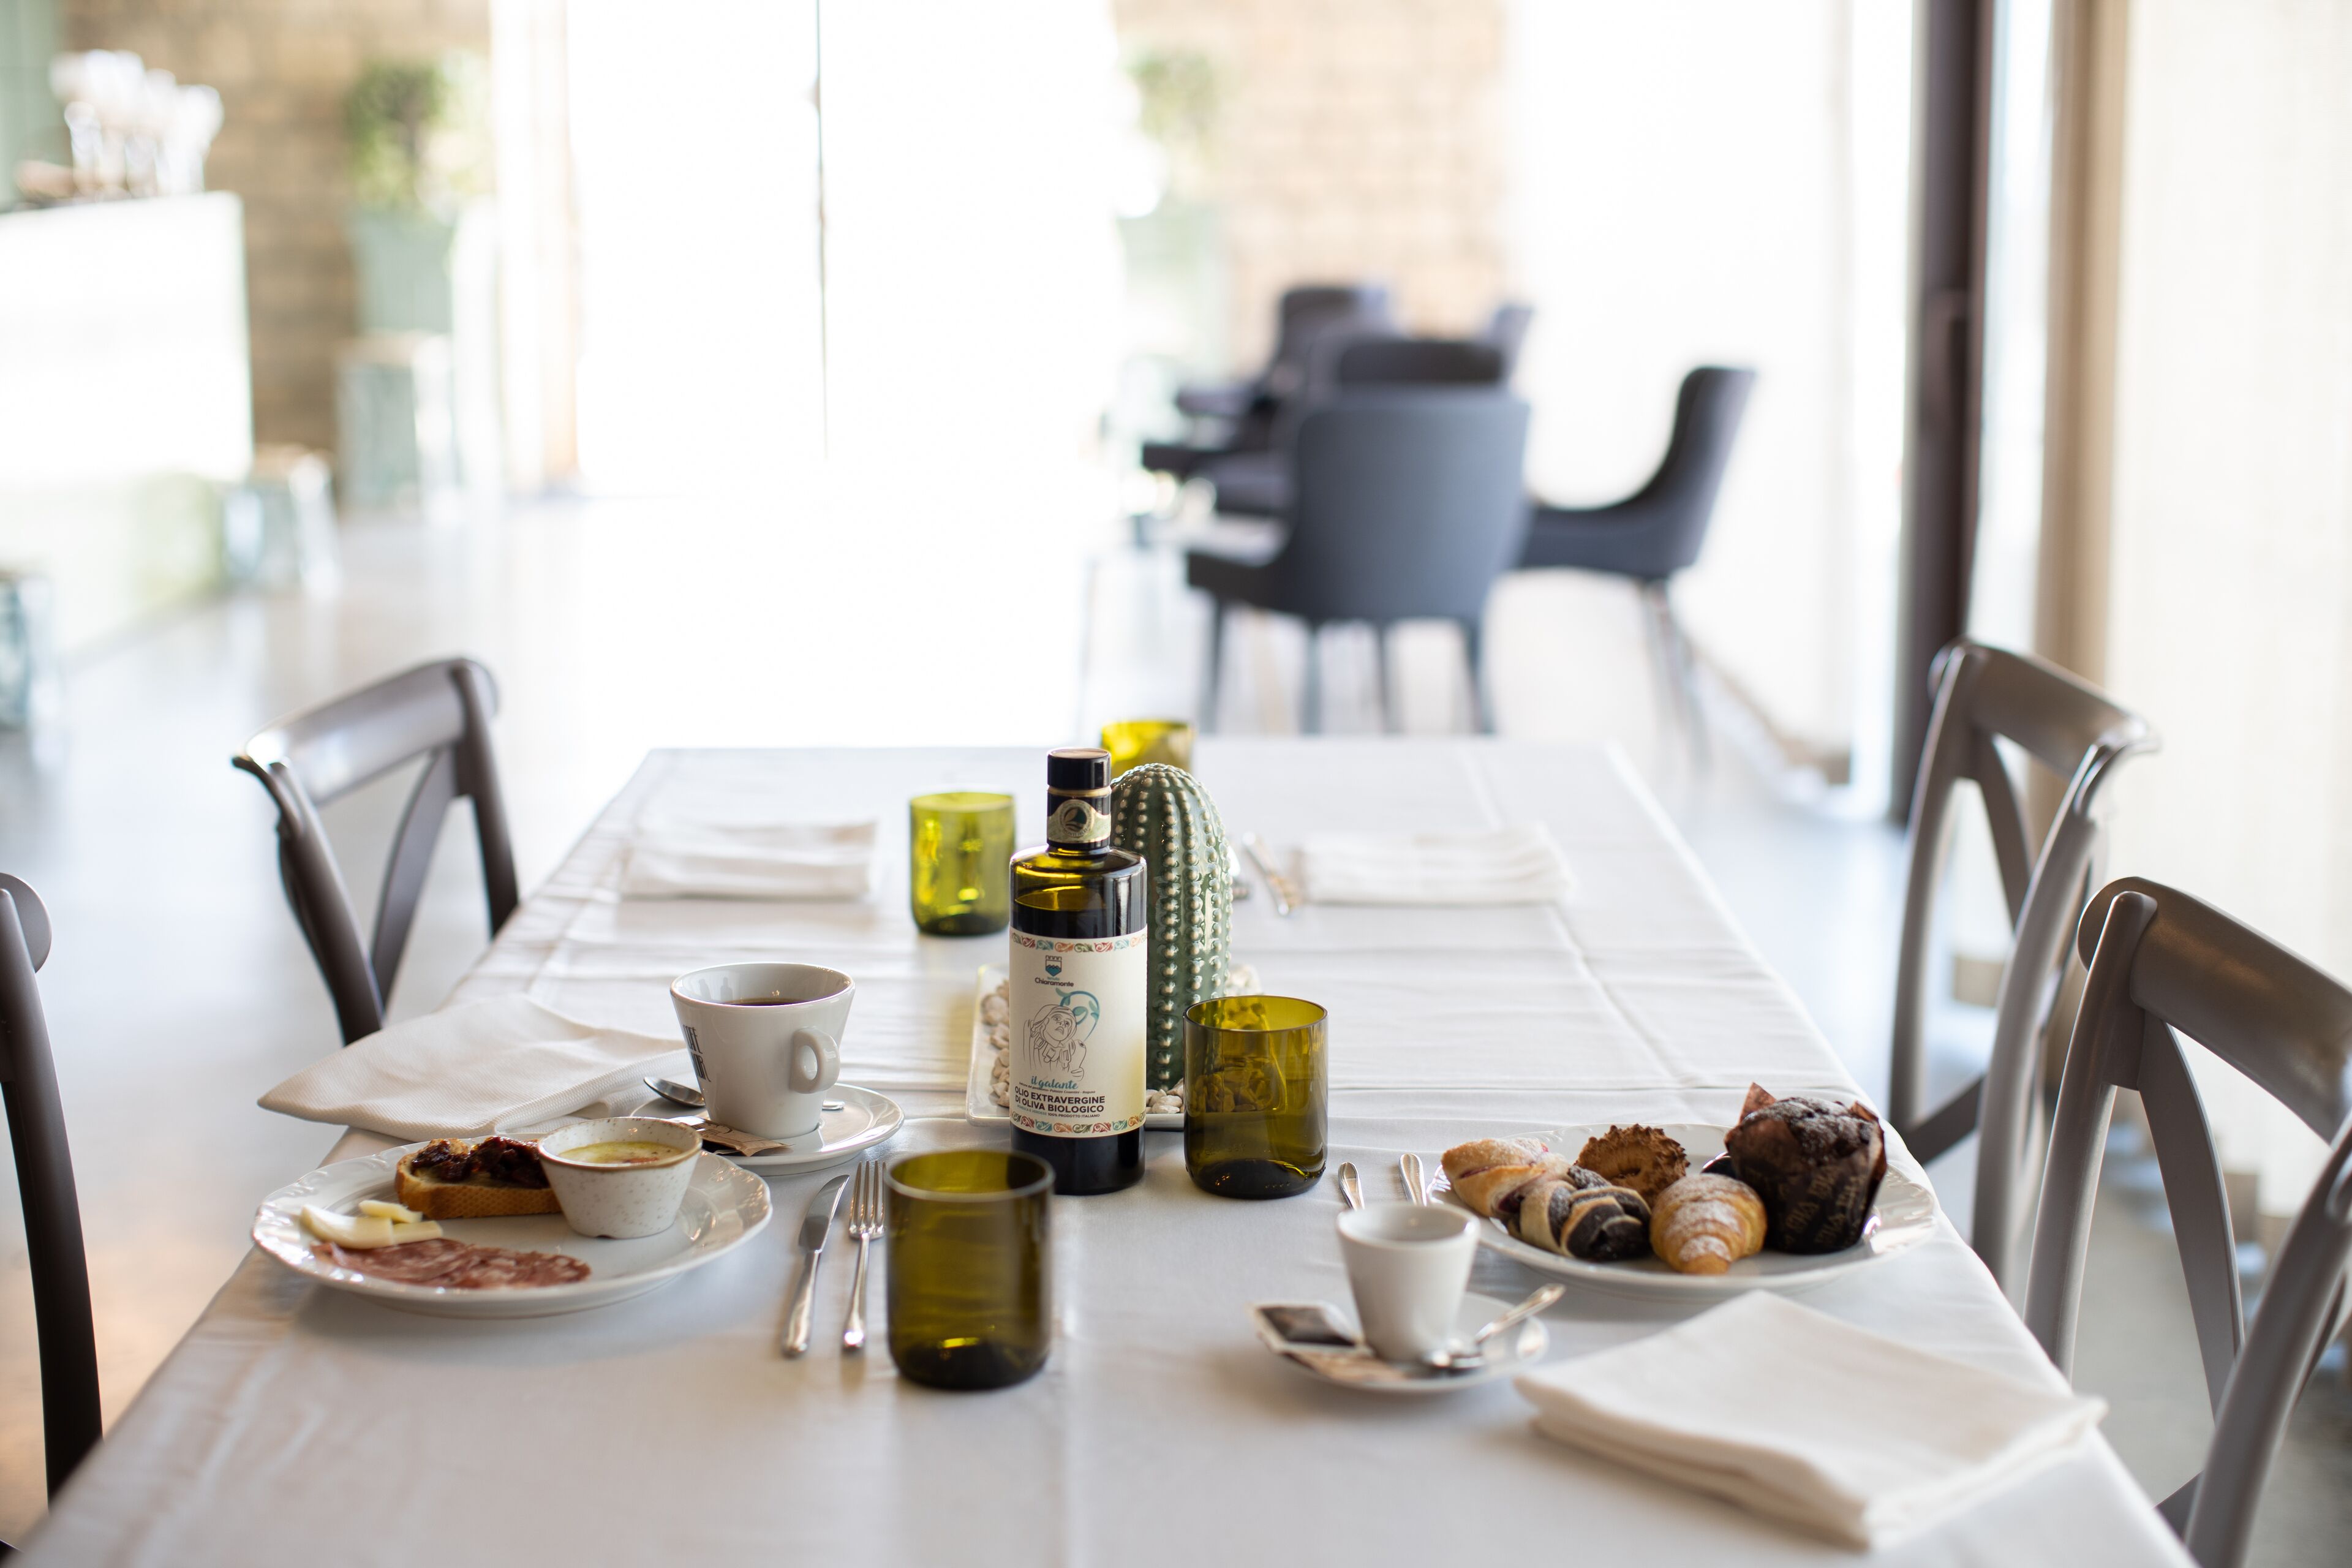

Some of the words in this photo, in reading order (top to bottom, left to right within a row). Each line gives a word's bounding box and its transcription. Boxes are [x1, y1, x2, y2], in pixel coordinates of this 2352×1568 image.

[1035, 977, 1074, 987] Chiaramonte
[1031, 1076, 1038, 1085] il
[1038, 1079, 1078, 1089] galante
[1015, 1086, 1029, 1098] OLIO
[1031, 1091, 1105, 1104] EXTRAVERGINE
[1015, 1095, 1021, 1104] DI
[1022, 1098, 1046, 1110] OLIVA
[1048, 1104, 1104, 1114] BIOLOGICO
